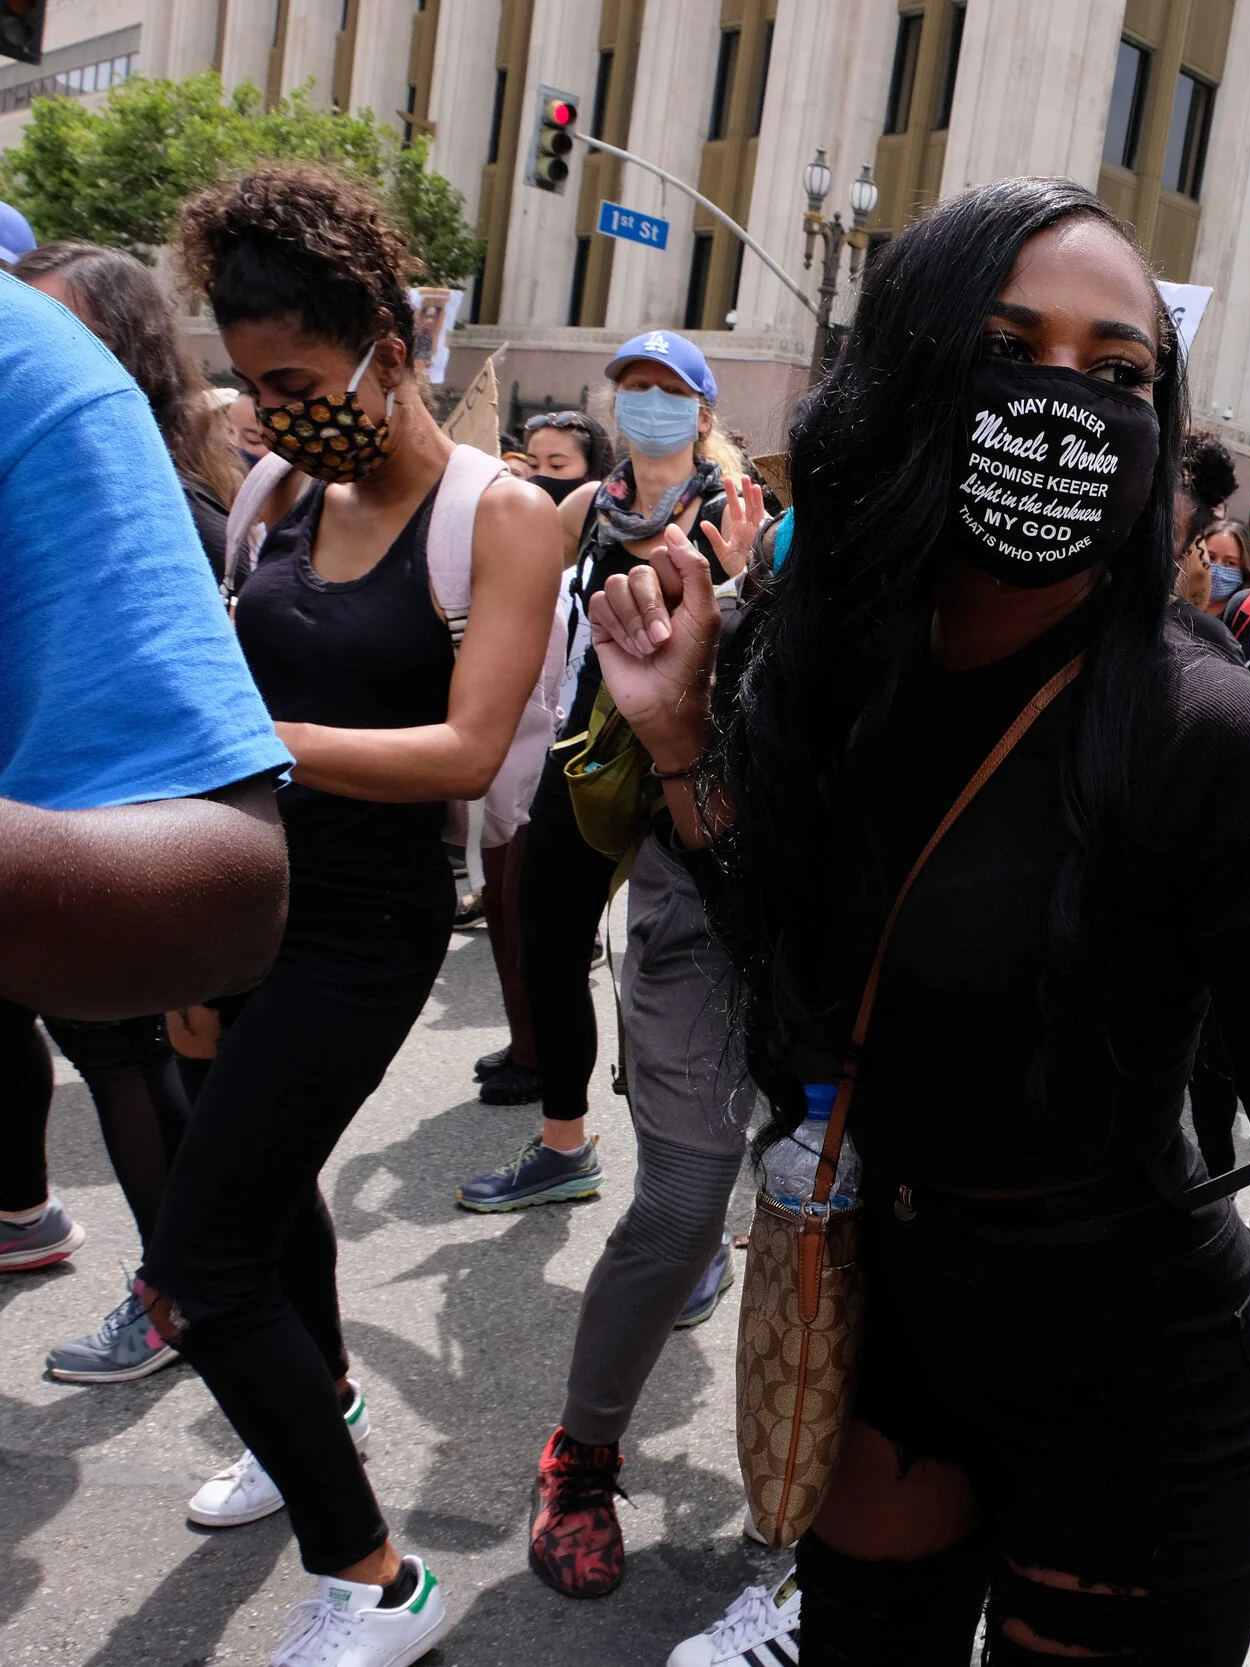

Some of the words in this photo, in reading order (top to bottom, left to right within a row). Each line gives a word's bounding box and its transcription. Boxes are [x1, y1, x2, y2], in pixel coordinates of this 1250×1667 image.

[612, 210, 635, 231] 1st
[638, 221, 659, 242] St
[1007, 398, 1048, 417] WAY
[1051, 400, 1106, 438] MAKER
[971, 410, 1049, 462] Miracle
[1058, 434, 1119, 474] Worker
[959, 472, 1002, 503] Light
[1000, 490, 1017, 509] in
[1018, 493, 1042, 514] the
[1042, 498, 1102, 522] darkness
[968, 452, 1045, 488] PROMISE
[1046, 476, 1109, 497] KEEPER
[958, 504, 985, 536] THAT
[982, 533, 997, 547] IS
[998, 541, 1033, 562] WHO
[1035, 548, 1066, 562] YOU
[1067, 535, 1092, 556] ARE
[983, 508, 1018, 531] MY
[1022, 521, 1072, 541] GOD
